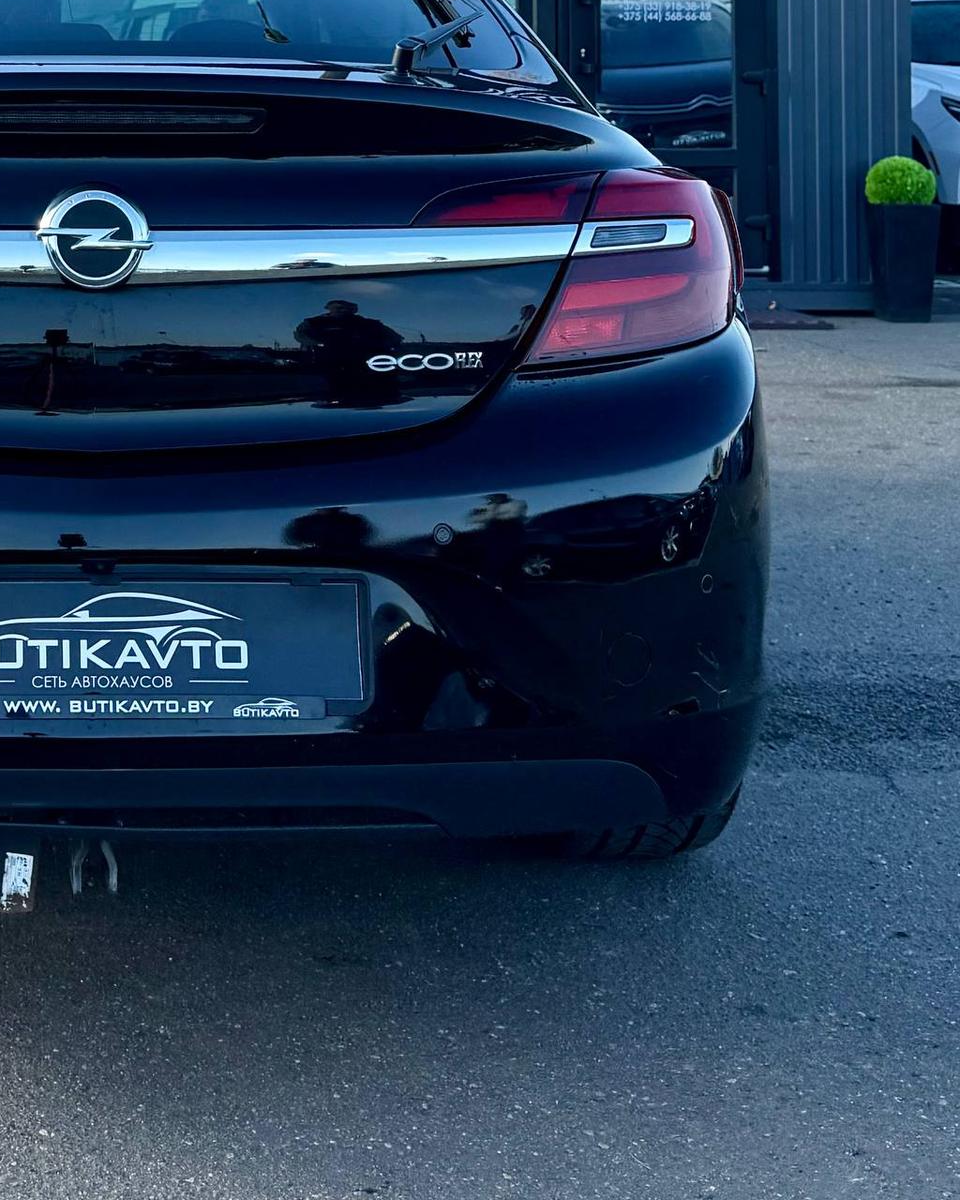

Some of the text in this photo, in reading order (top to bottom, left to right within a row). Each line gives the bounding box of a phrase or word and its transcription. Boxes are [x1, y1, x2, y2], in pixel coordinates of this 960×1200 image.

[617, 11, 712, 23] +375 (44) 568-66-88
[31, 675, 173, 689] СЕТЬ АВТОХАУСОВ
[3, 699, 214, 714] WWW. BUTIKAVTO.BY
[233, 707, 300, 717] BUTIKAVTO
